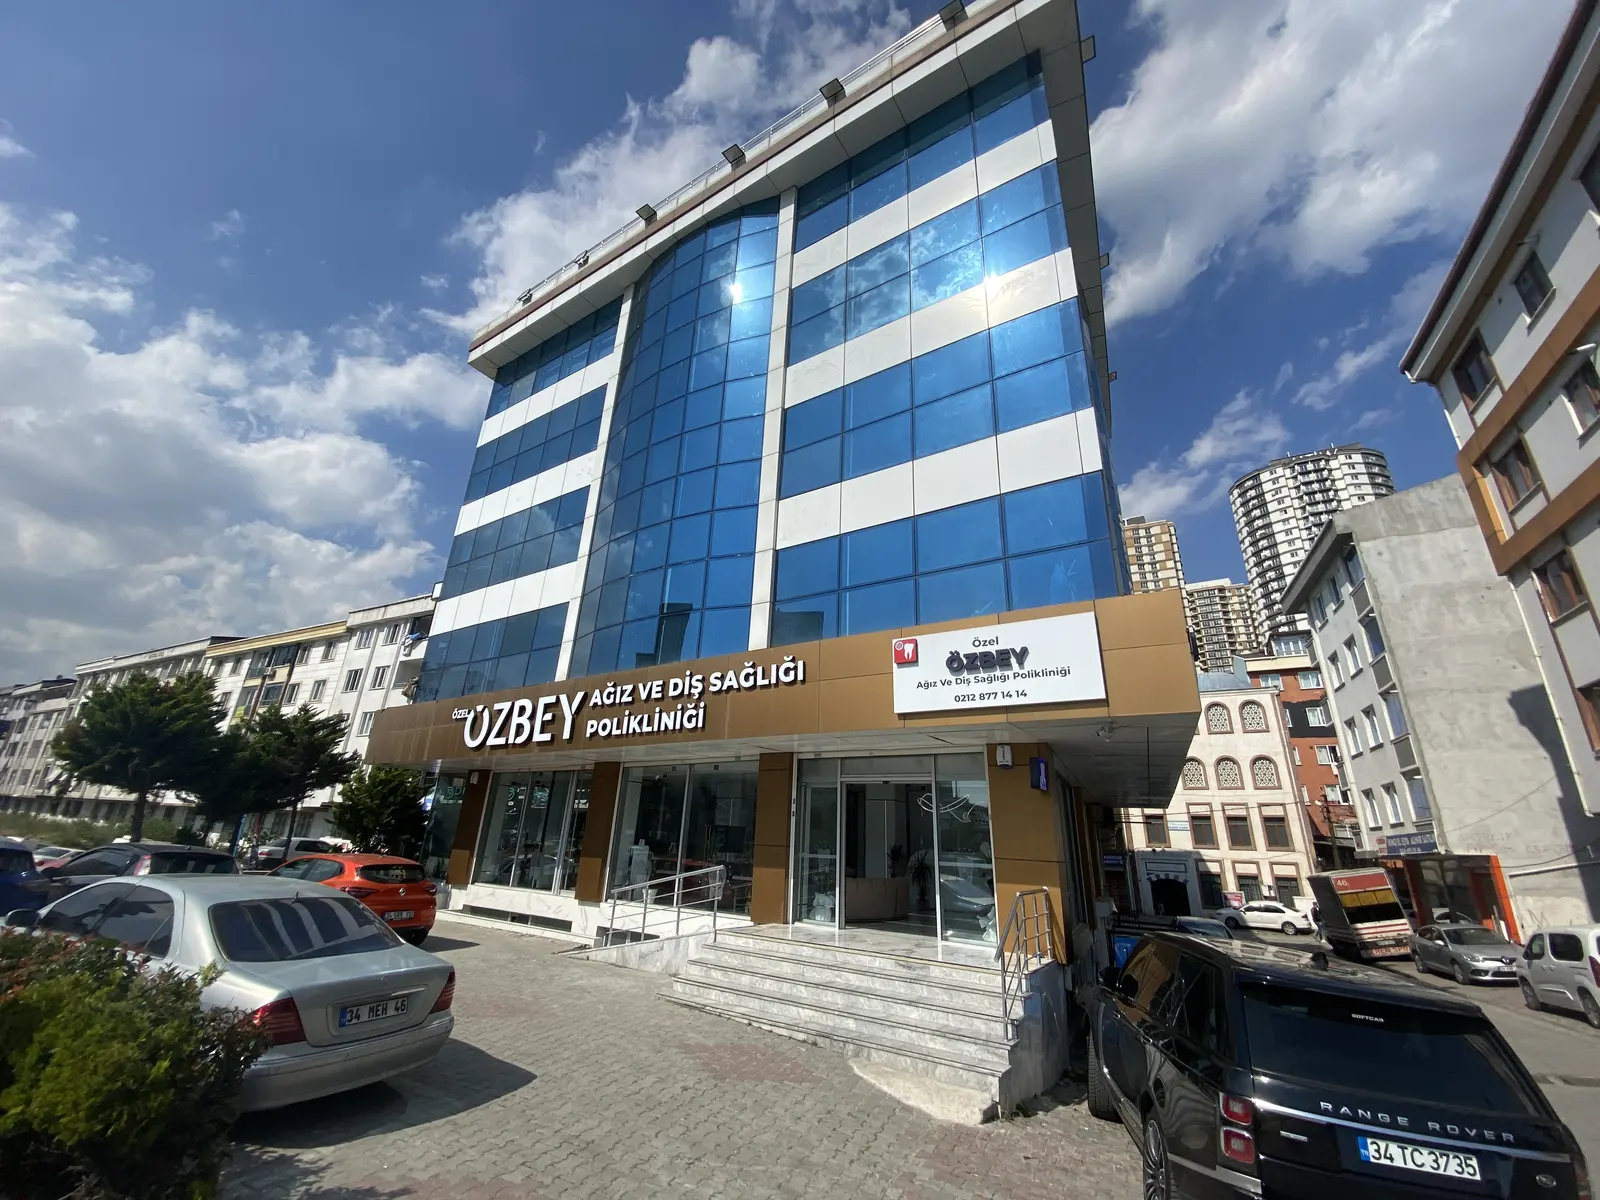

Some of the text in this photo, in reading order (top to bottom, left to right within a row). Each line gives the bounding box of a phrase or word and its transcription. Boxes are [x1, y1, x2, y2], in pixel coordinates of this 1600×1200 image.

[972, 636, 999, 648] Özel
[945, 646, 1028, 672] ÖZBEY
[589, 655, 804, 707] AĞIZ VE DİŞ SAĞLIĞI
[916, 666, 1071, 690] Ağız Ve Diş Sağlığı Polikliniği
[954, 689, 1028, 703] 0212 877 14 14
[452, 708, 469, 719] ÖZEL
[463, 690, 586, 748] ÖZBEY
[585, 701, 705, 738] POLİKLİNİĞİ
[347, 999, 406, 1023] 34 MEH 46
[1320, 1101, 1515, 1143] RANGE ROVER
[1370, 1141, 1477, 1177] 34 TC 3735
